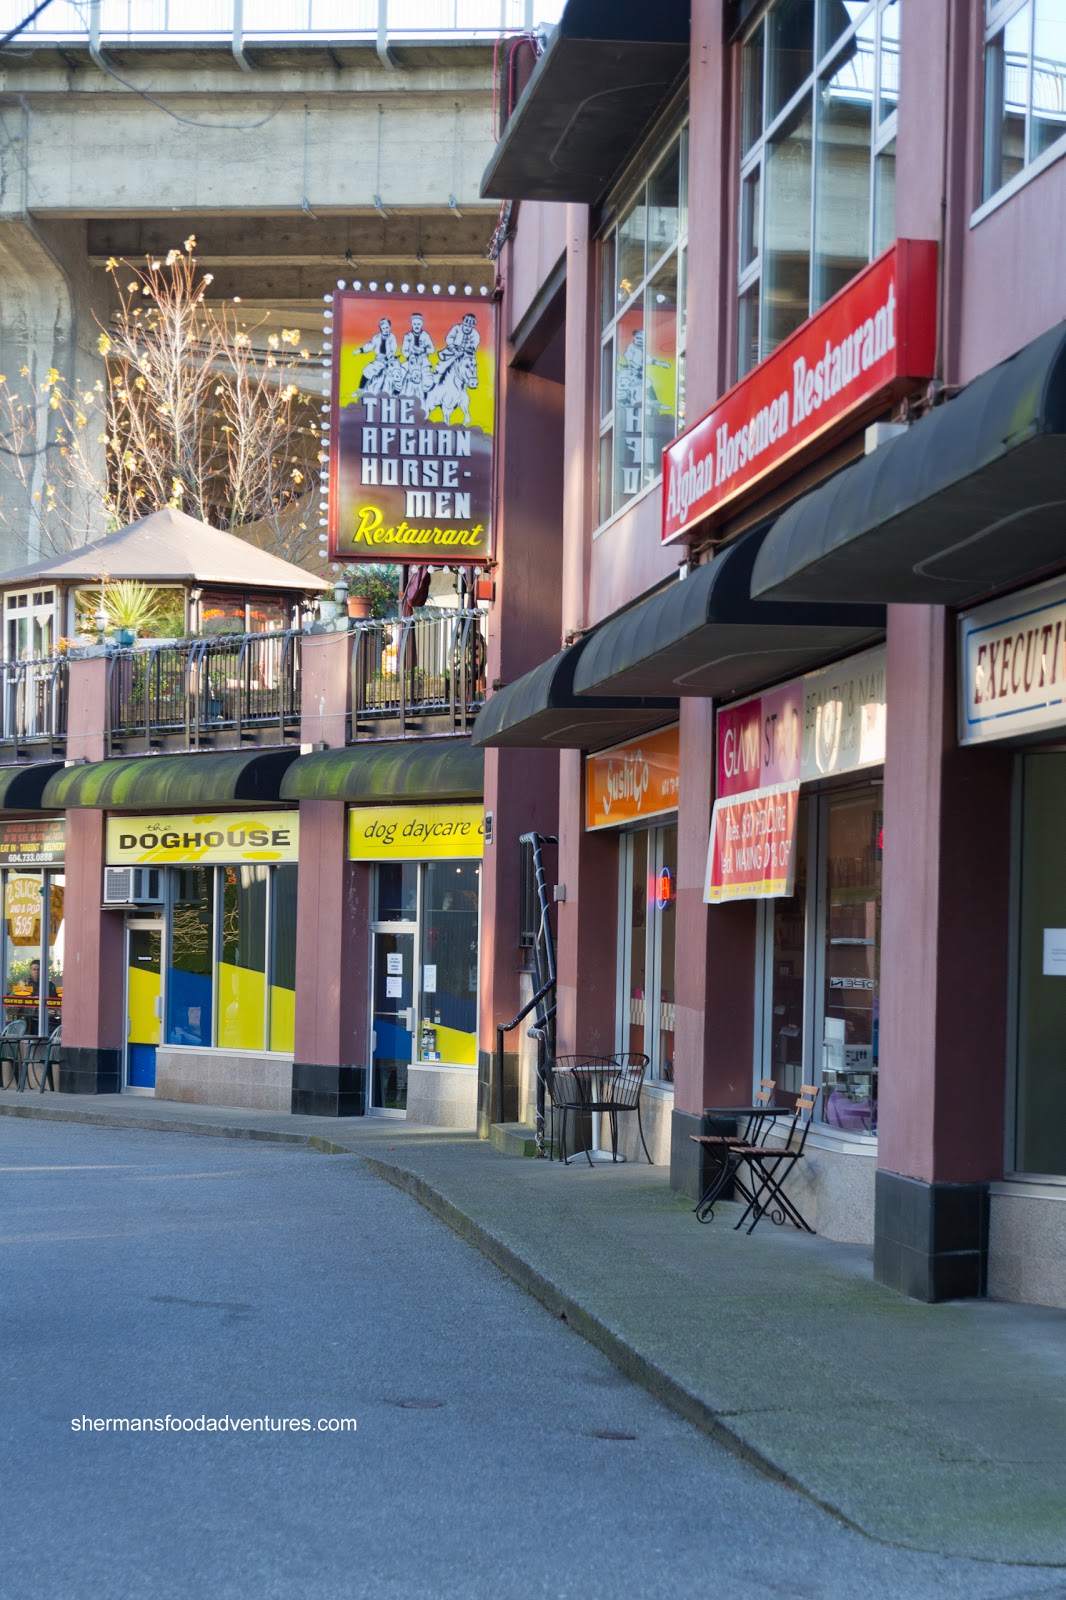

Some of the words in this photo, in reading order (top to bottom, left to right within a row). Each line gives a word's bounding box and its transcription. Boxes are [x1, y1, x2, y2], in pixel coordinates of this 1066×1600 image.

[361, 396, 416, 425] THE
[666, 451, 713, 524] Afghan
[715, 390, 789, 487] Horsemen
[792, 276, 897, 428] Restaurant
[361, 426, 472, 457] AFGHAN
[361, 457, 472, 488] HORSE-
[404, 490, 472, 519] MEN
[354, 506, 484, 547] Restaurant
[974, 620, 1066, 705] EXECUTI
[723, 717, 761, 779] GLAM
[144, 822, 173, 832] the
[364, 819, 399, 845] dog
[402, 818, 472, 843] daycare
[755, 805, 787, 837] PEDCURE
[0, 844, 10, 853] EAT
[10, 843, 17, 852] IN
[19, 843, 40, 852] TAKEOUT
[43, 841, 66, 851] DELIVERY
[119, 829, 292, 850] DOGHOUSE
[720, 848, 734, 874] ed.
[735, 844, 763, 872] WAXING
[7, 884, 15, 905] 2
[10, 904, 21, 914] AND
[21, 904, 26, 914] A
[26, 903, 41, 915] POP
